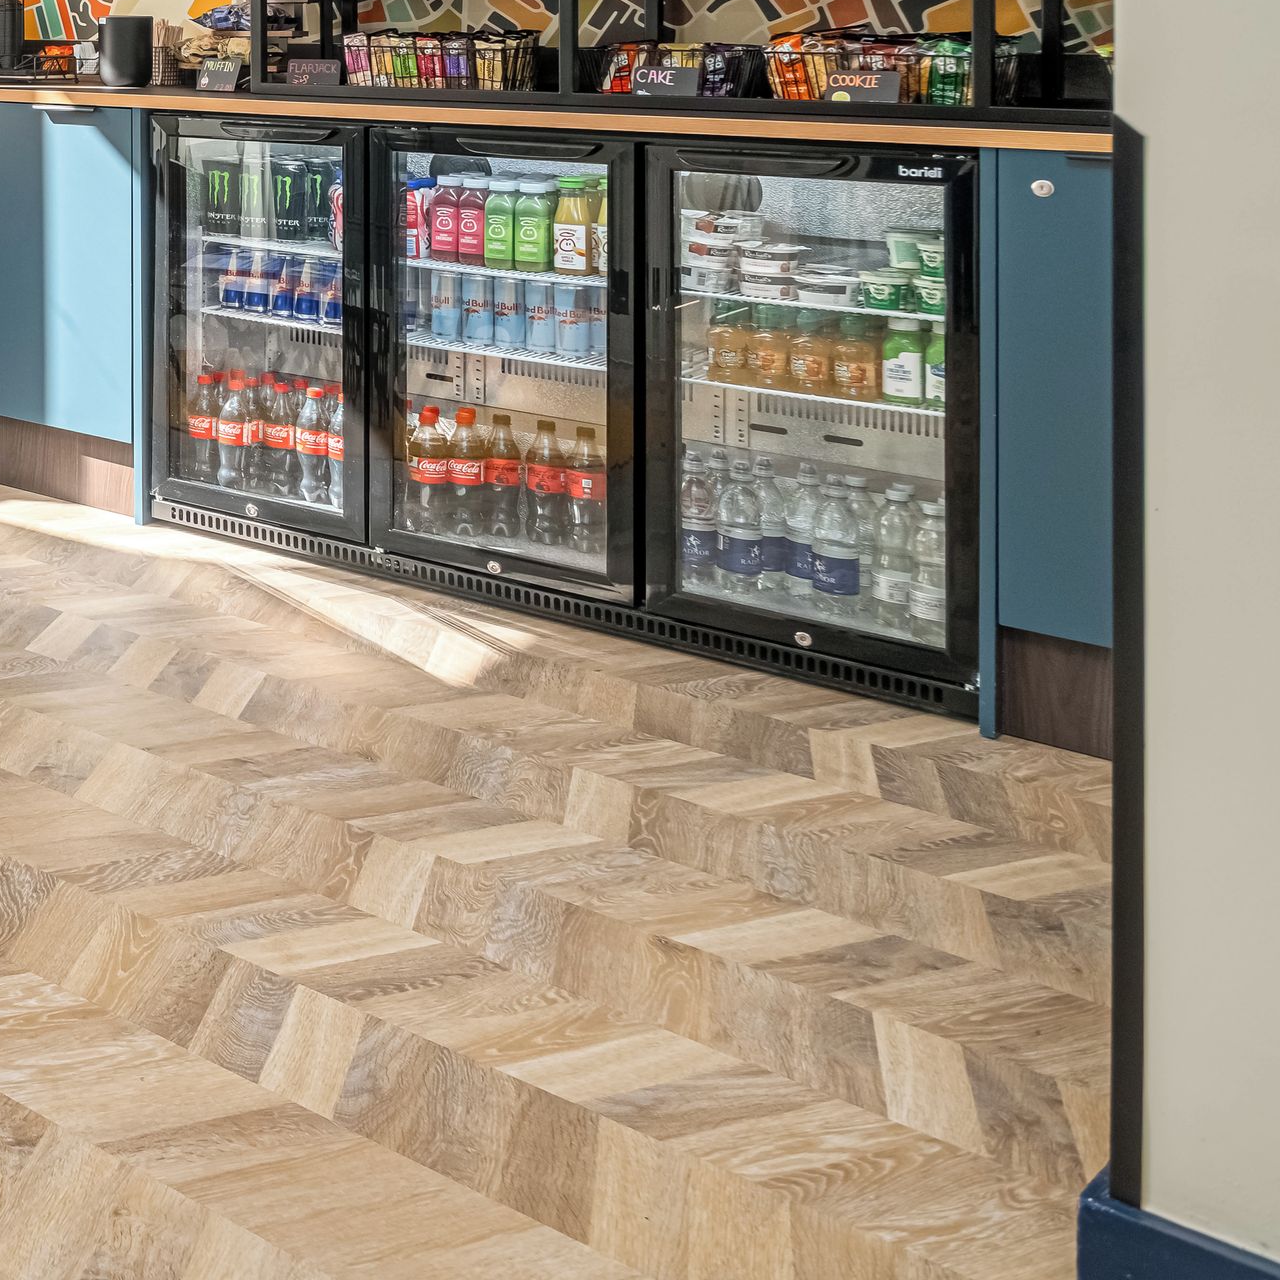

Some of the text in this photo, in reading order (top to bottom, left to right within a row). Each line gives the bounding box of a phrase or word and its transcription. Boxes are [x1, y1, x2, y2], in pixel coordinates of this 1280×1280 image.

[203, 60, 236, 72] MUFFIN
[289, 62, 337, 74] FLAPJACK
[635, 68, 676, 86] CAKE
[829, 74, 881, 88] COOKIE
[898, 165, 943, 178] baridi
[434, 295, 449, 305] Bull
[472, 300, 489, 308] Bull
[501, 302, 518, 311] Bull
[684, 546, 710, 556] ADNOR
